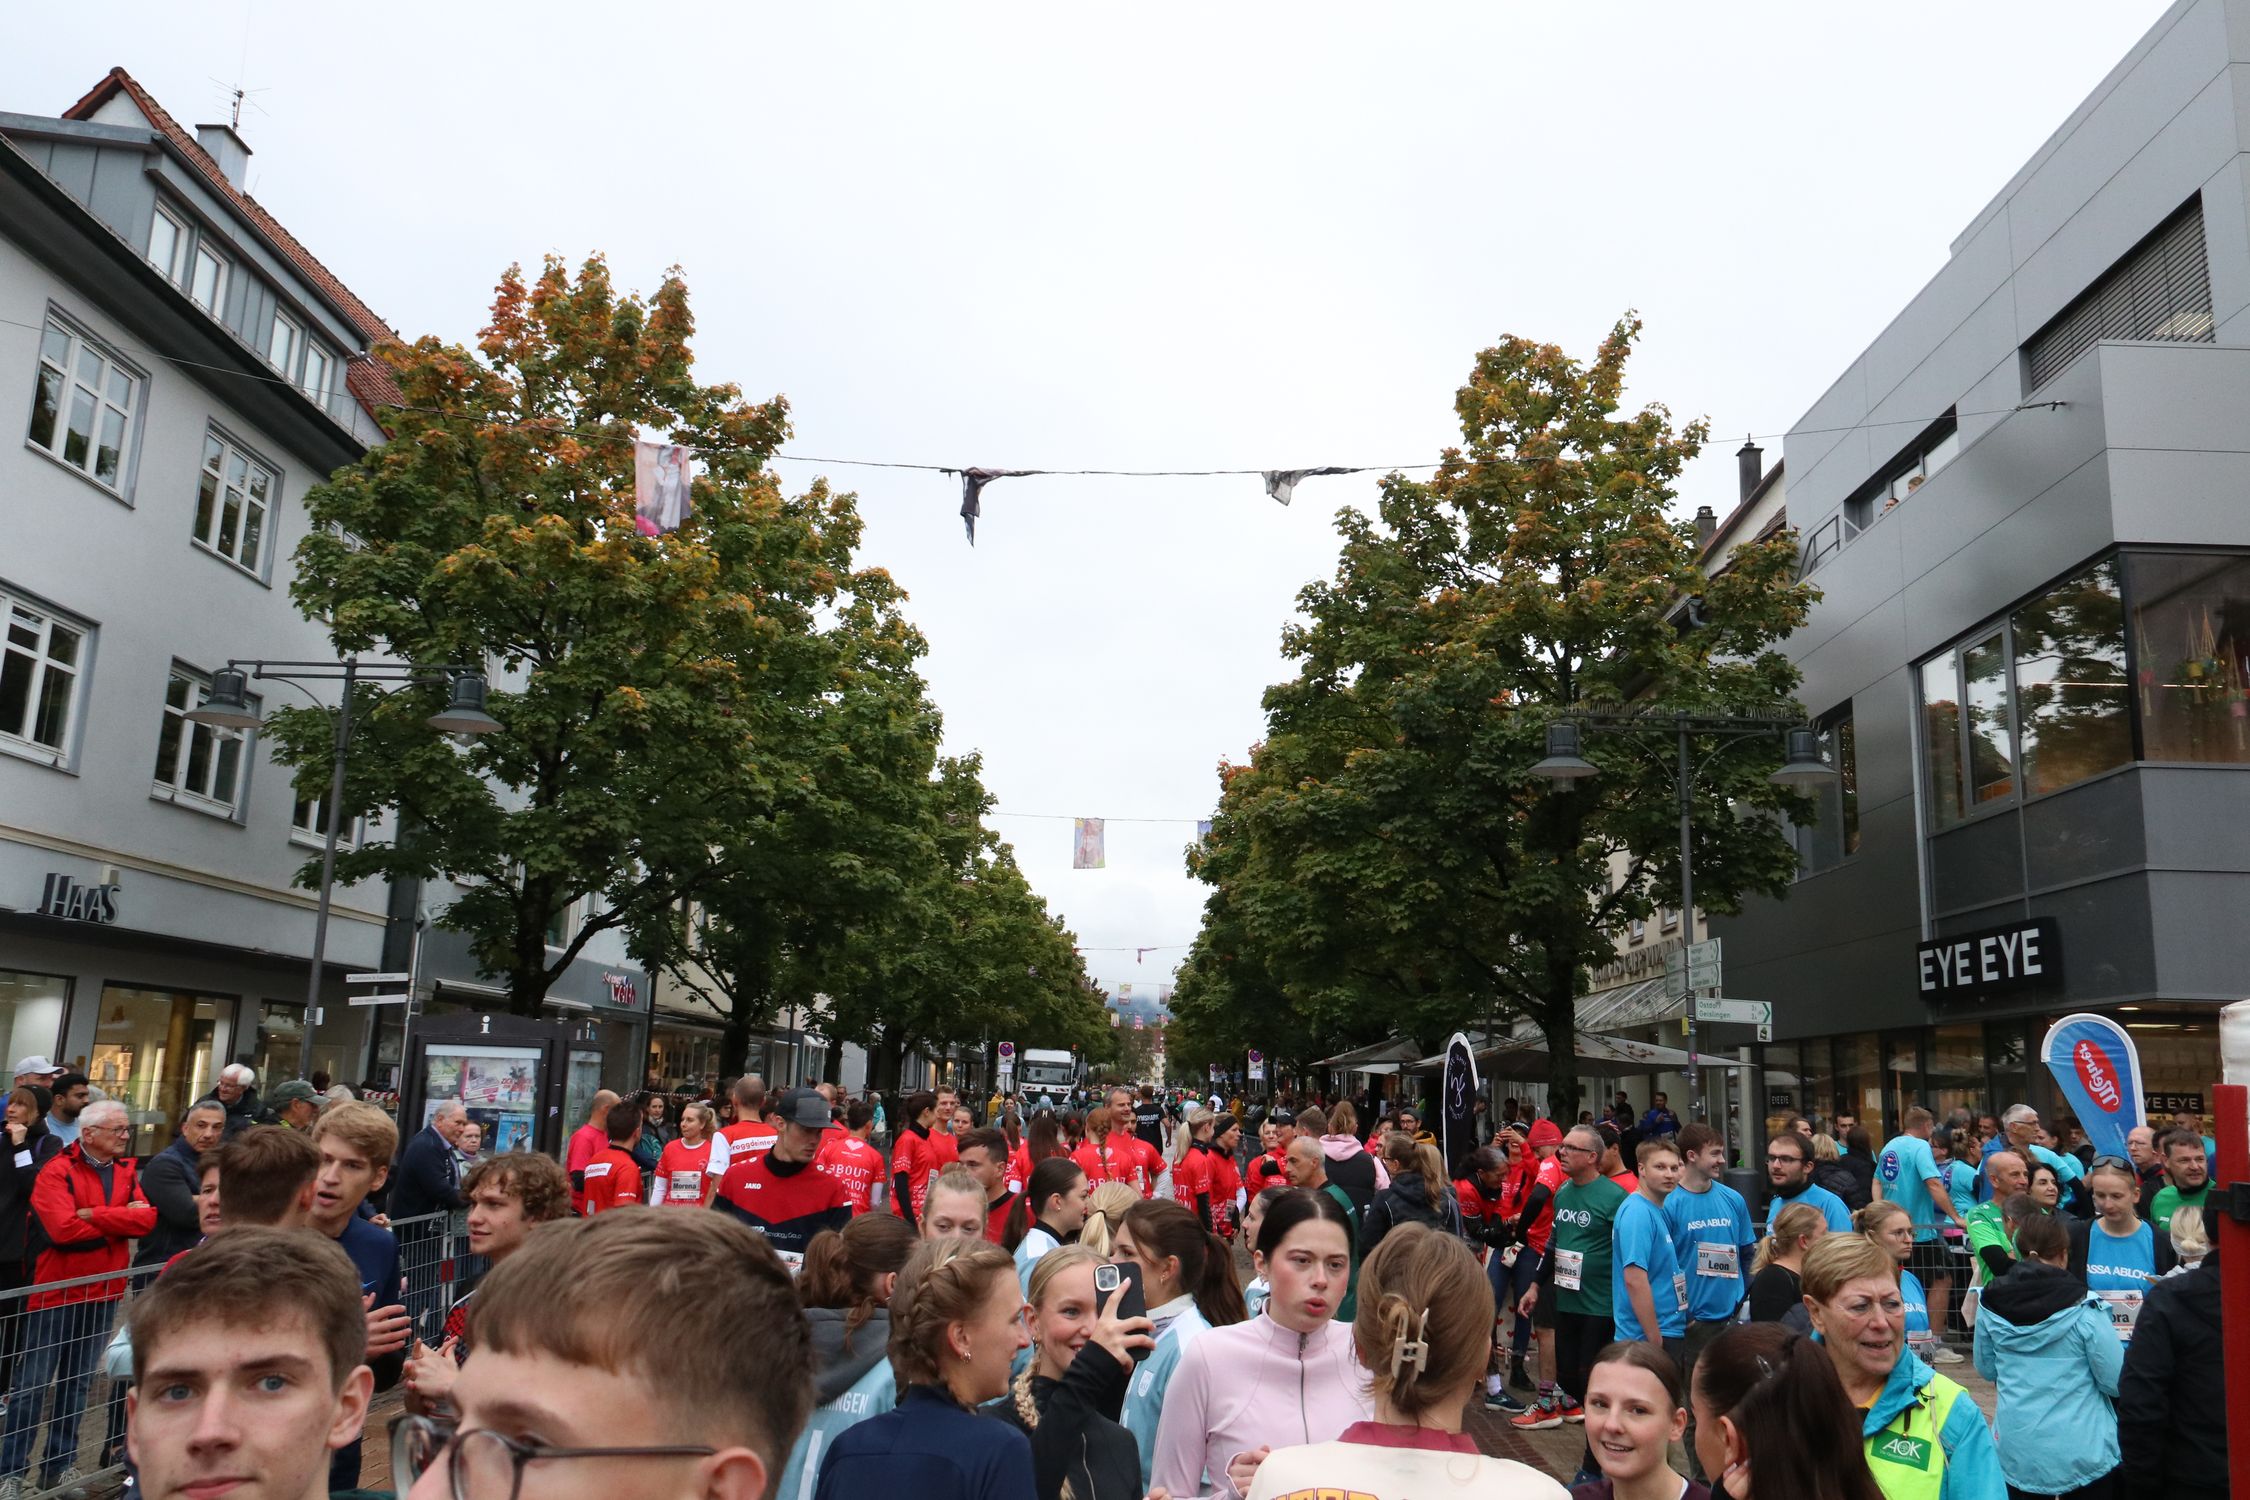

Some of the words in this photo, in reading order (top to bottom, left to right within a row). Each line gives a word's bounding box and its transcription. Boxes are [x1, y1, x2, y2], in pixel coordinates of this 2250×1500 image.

[44, 873, 121, 924] HAAS
[1919, 942, 1973, 991] EYE
[1980, 928, 2042, 982] EYE
[1699, 1010, 1731, 1020] Geislingen
[2144, 1097, 2162, 1109] YE
[2167, 1097, 2199, 1110] EYE
[672, 1182, 697, 1190] Morena
[744, 1182, 762, 1190] JAKO
[1556, 1208, 1578, 1224] AOK
[1687, 1220, 1707, 1232] ASSA
[1707, 1218, 1732, 1228] ABLOY
[1708, 1260, 1730, 1271] Leon
[2086, 1263, 2112, 1275] ASSA
[2112, 1266, 2149, 1281] ABLOY
[2112, 1313, 2130, 1323] ora
[1882, 1438, 1923, 1459] AOK
